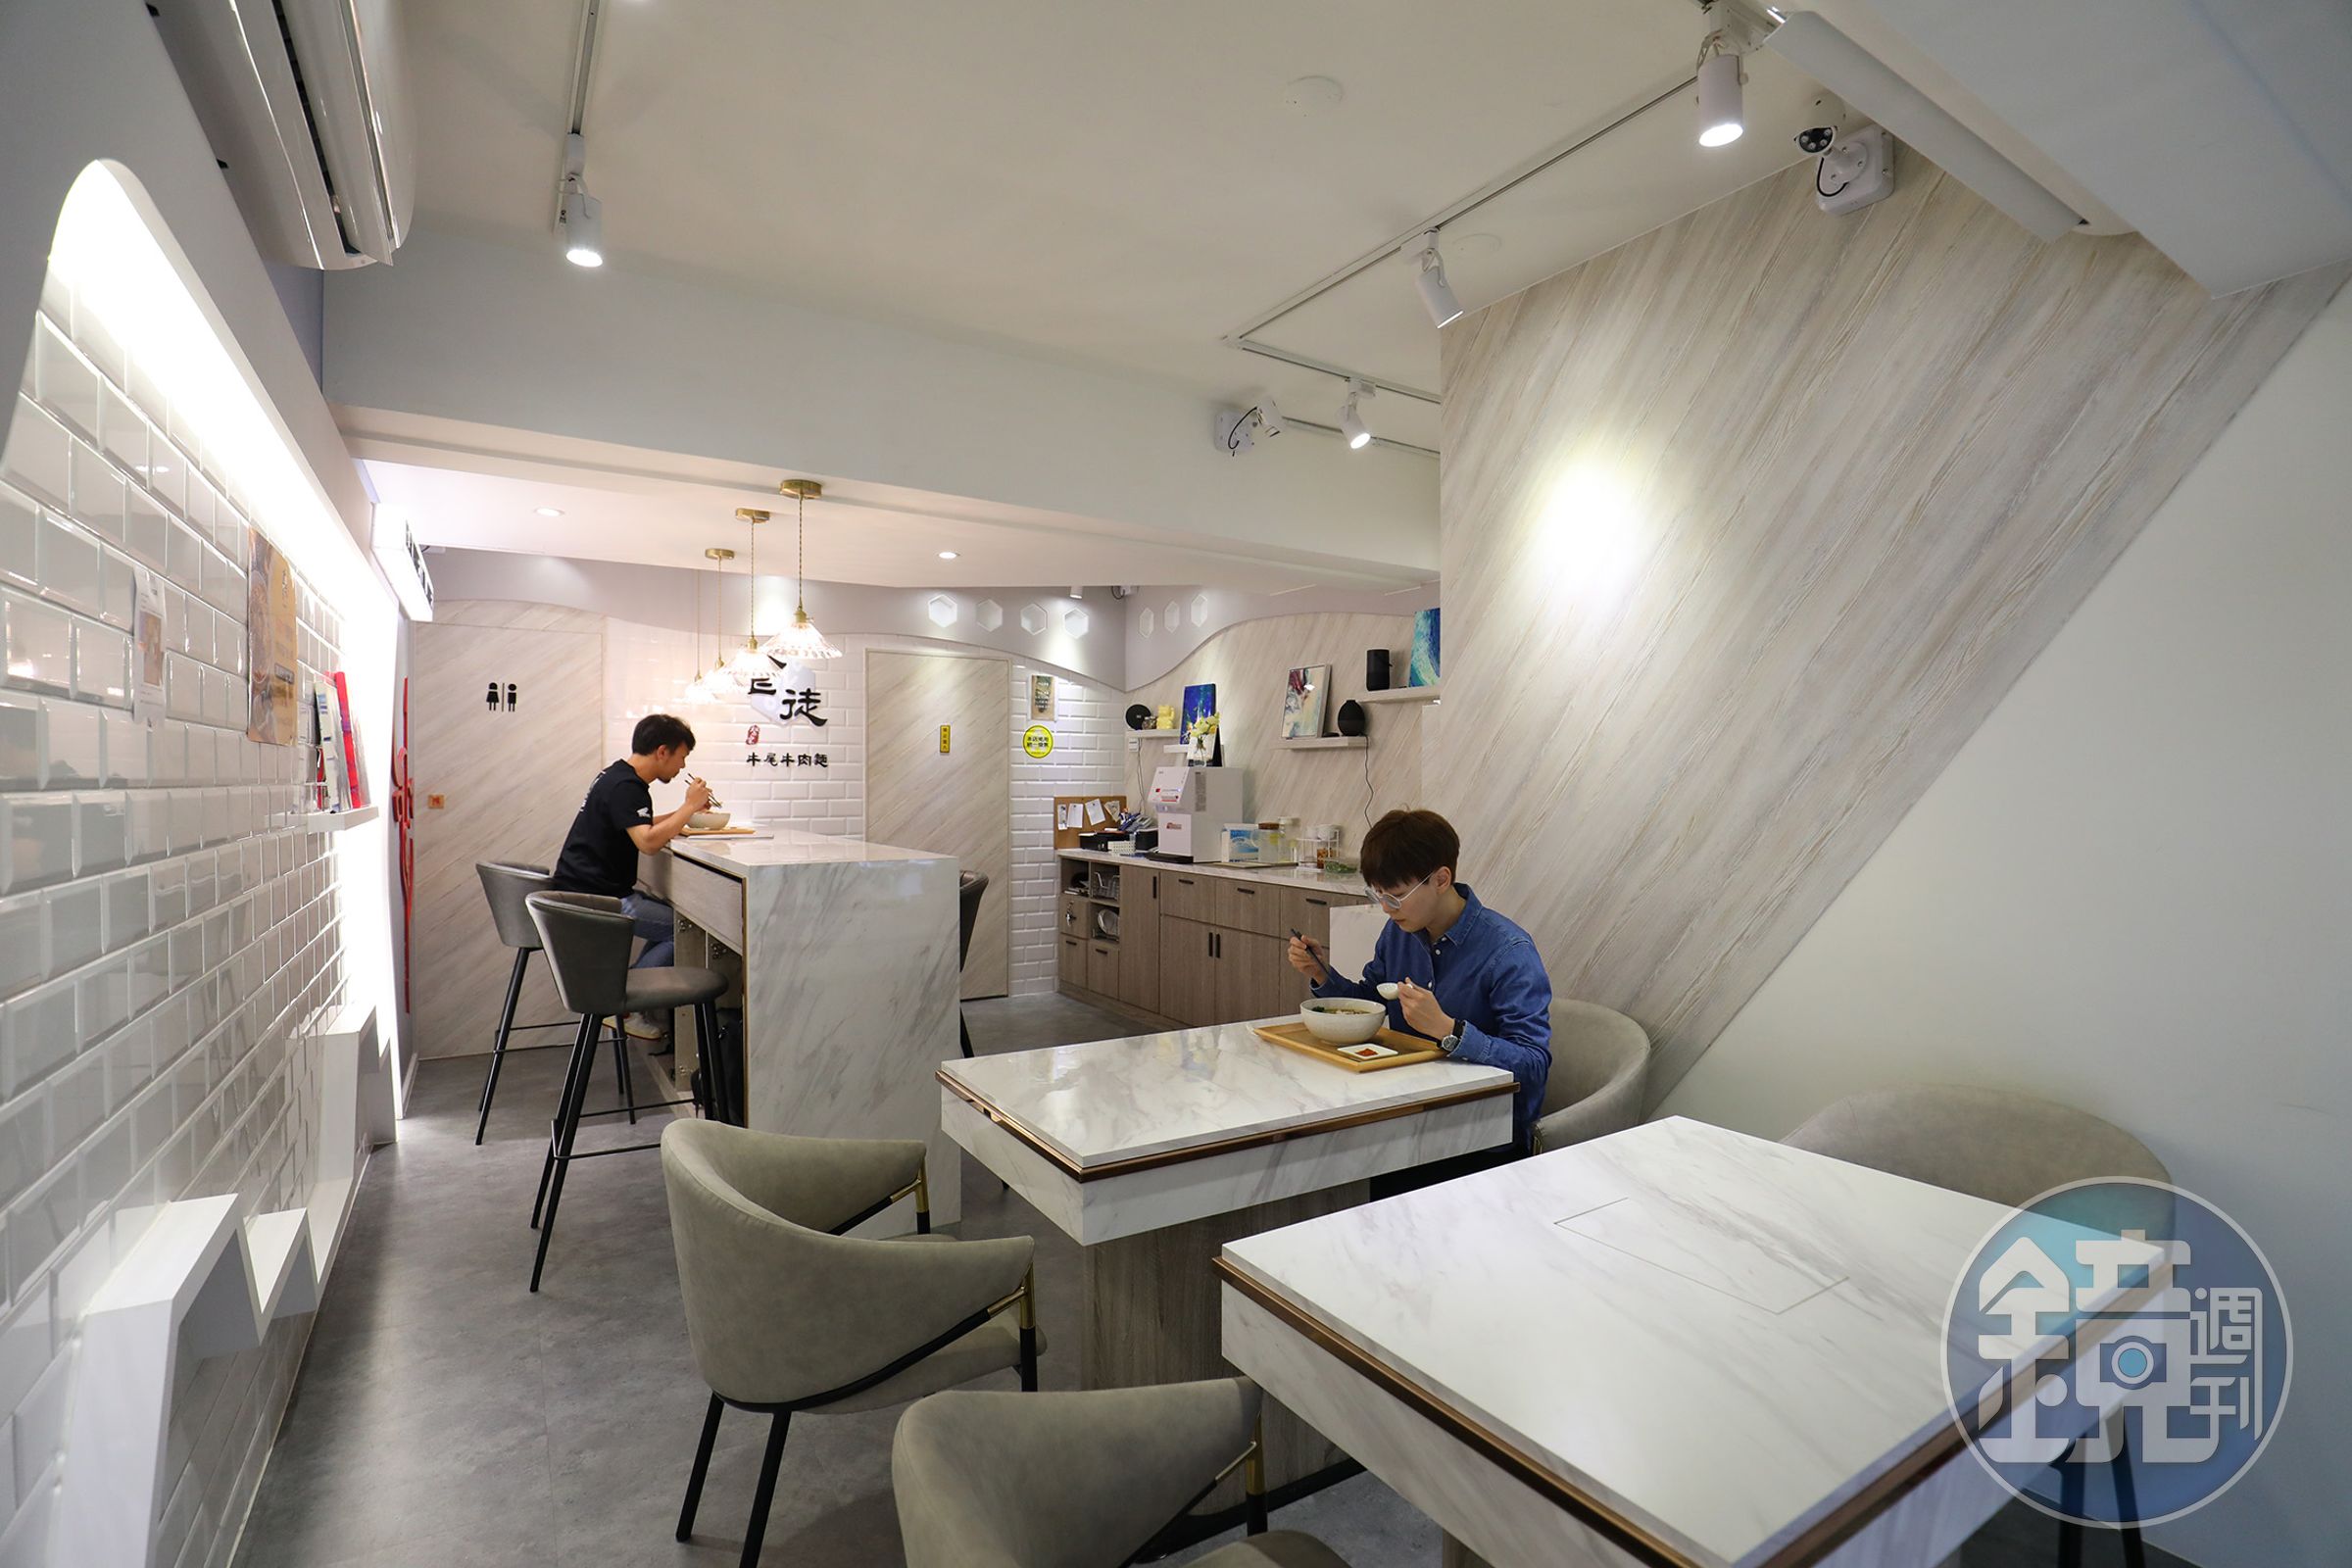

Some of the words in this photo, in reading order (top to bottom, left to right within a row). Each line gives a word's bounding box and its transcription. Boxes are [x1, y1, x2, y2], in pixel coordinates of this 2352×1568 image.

[746, 752, 828, 767] 牛尾牛肉麵
